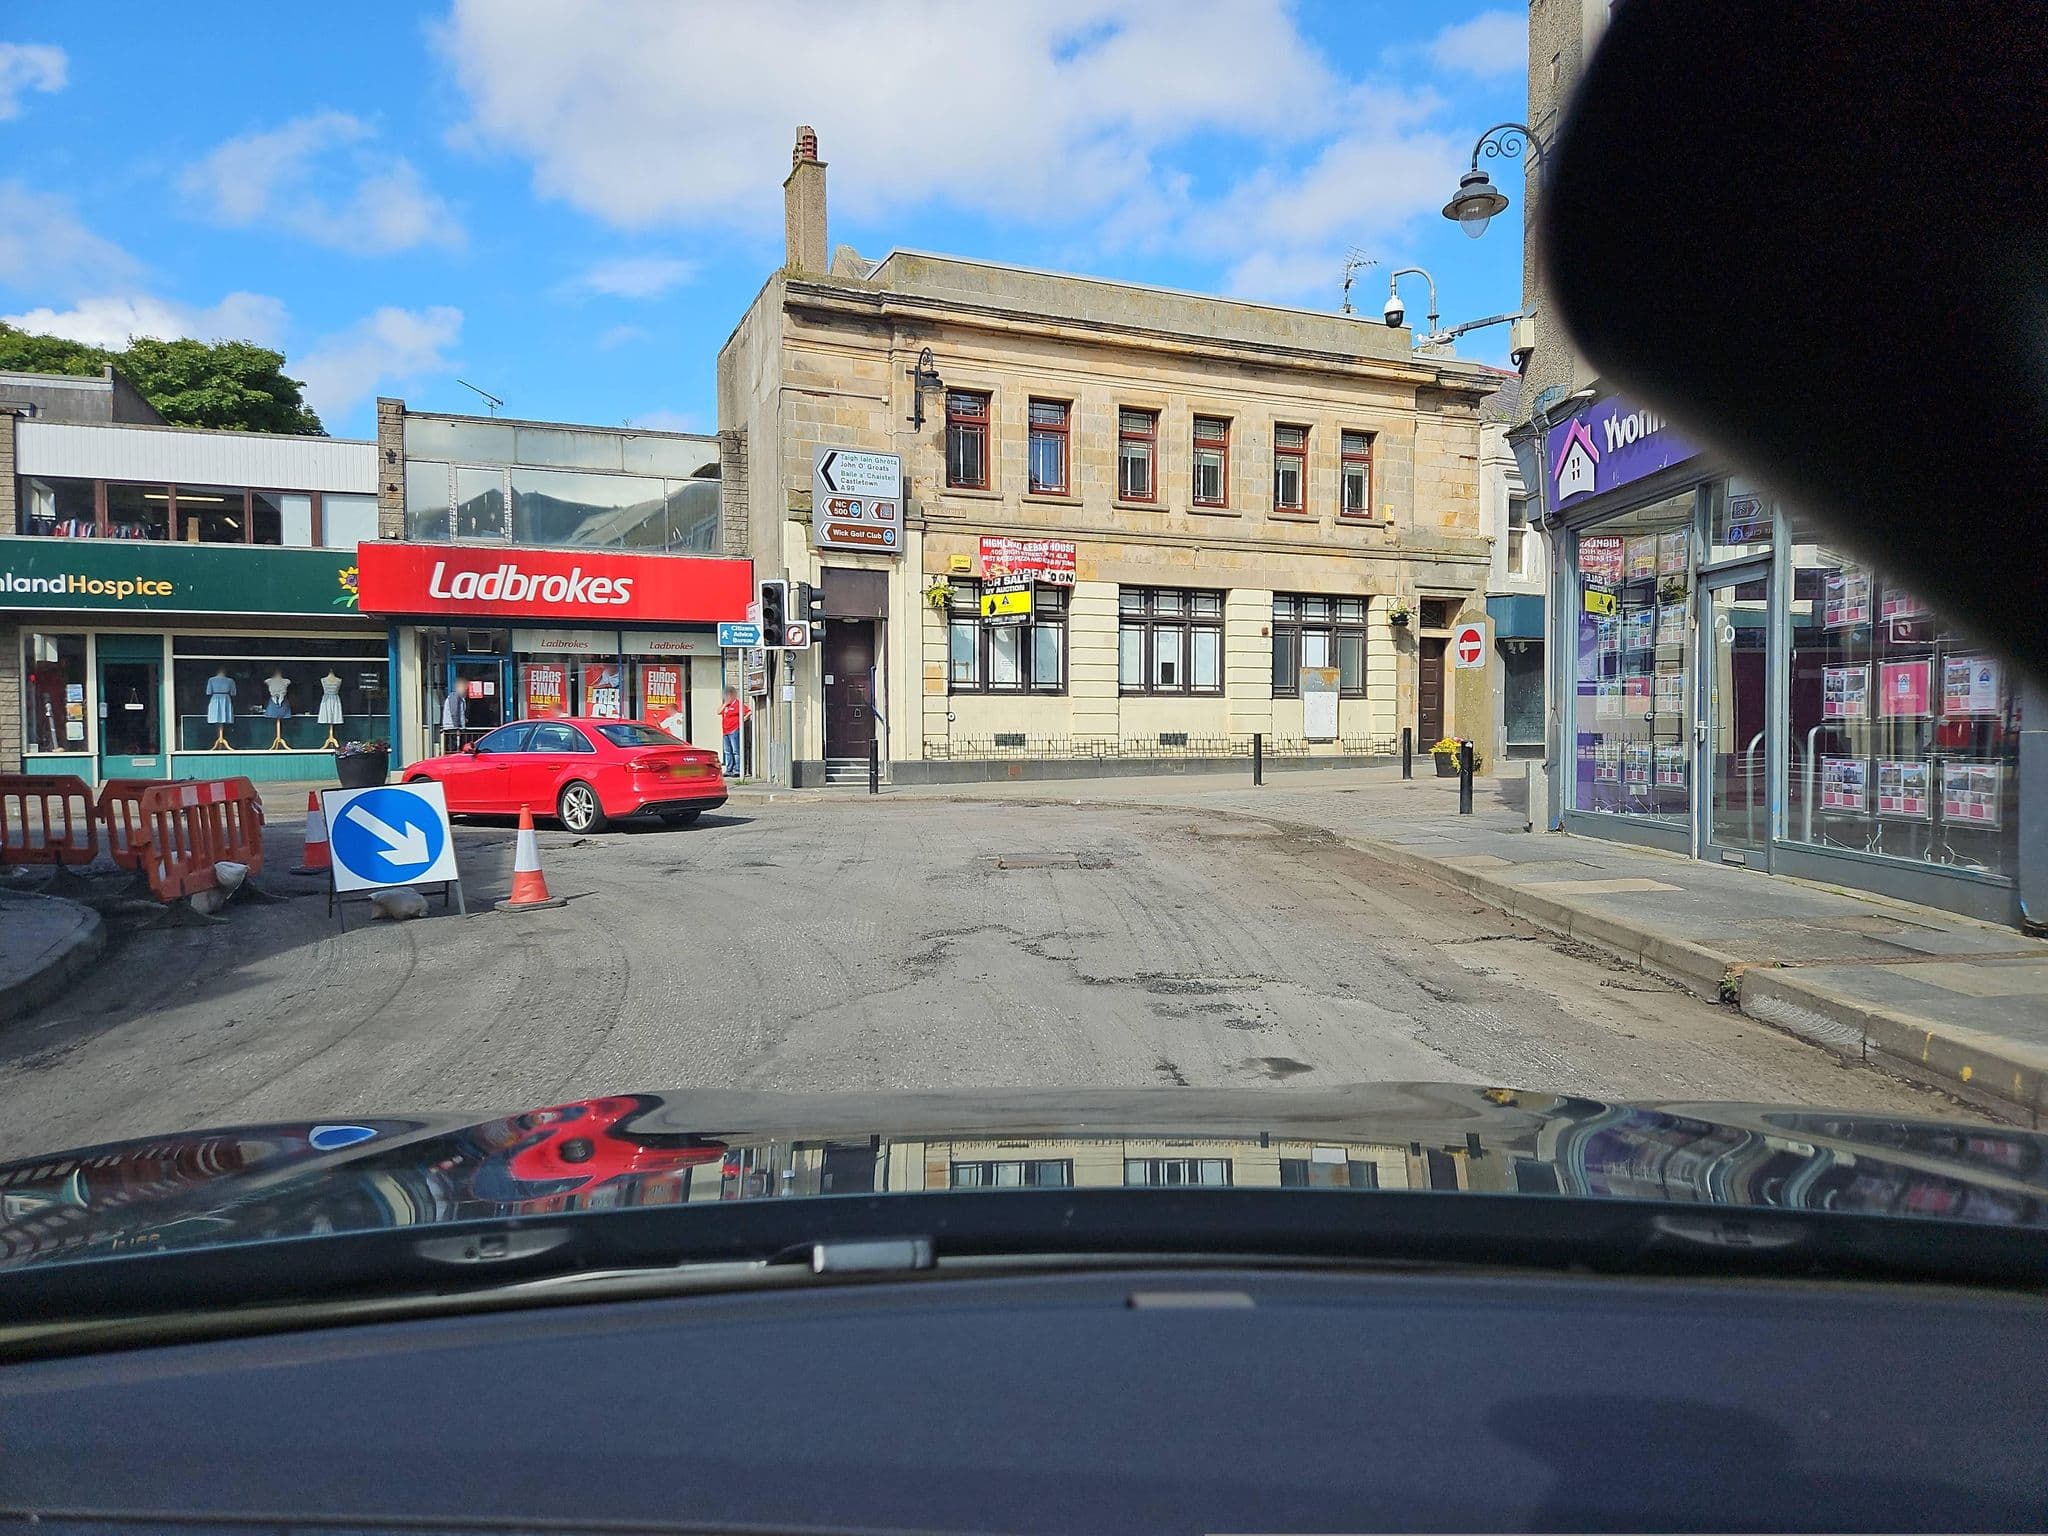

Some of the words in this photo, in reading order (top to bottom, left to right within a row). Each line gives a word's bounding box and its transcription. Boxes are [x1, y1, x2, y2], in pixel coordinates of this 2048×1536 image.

[867, 464, 889, 472] Groats
[840, 478, 878, 486] Castletown
[832, 528, 849, 536] Wick
[866, 531, 882, 539] Club
[1049, 542, 1075, 553] HOUSE
[982, 578, 1001, 587] FOR
[1004, 574, 1031, 585] SALE
[1047, 571, 1074, 582] OON
[429, 562, 634, 604] Ladbrokes
[996, 584, 1025, 593] AUCTION
[540, 639, 589, 648] Ladbrokes
[649, 641, 695, 650] Ladbrokes
[530, 670, 562, 683] EUROS
[648, 670, 676, 683] EUROS
[530, 683, 560, 696] FINAL
[647, 683, 676, 696] FINAL
